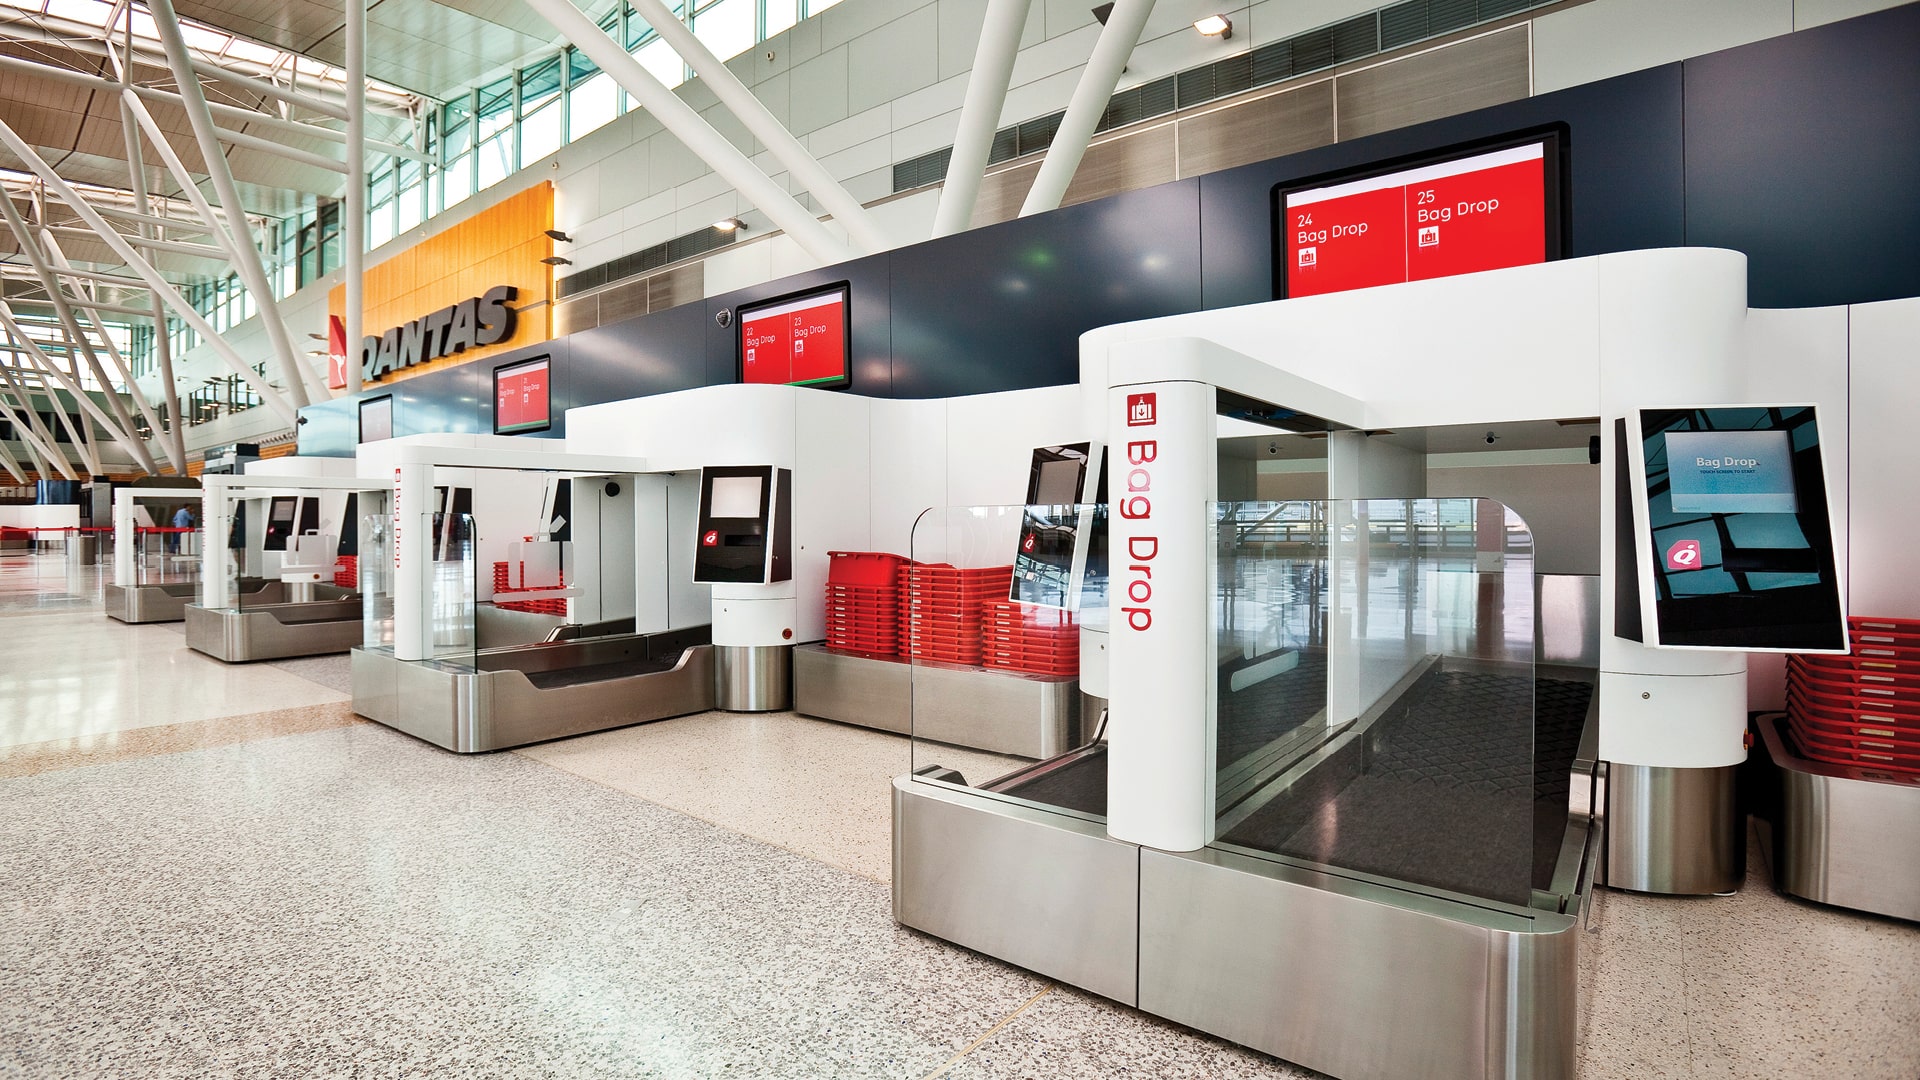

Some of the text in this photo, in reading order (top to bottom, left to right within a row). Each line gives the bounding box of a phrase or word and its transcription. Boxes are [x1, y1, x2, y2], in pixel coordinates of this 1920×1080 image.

[1417, 189, 1435, 205] 25
[1418, 197, 1499, 223] Bag Drop
[1297, 213, 1313, 227] 24
[1298, 220, 1368, 244] Bag Drop
[794, 317, 802, 326] 23
[747, 327, 753, 335] 22
[794, 324, 826, 338] Bag Drop
[747, 334, 776, 347] Bag Drop
[1696, 456, 1758, 469] Bag Drop
[1119, 440, 1158, 632] Bag Drop
